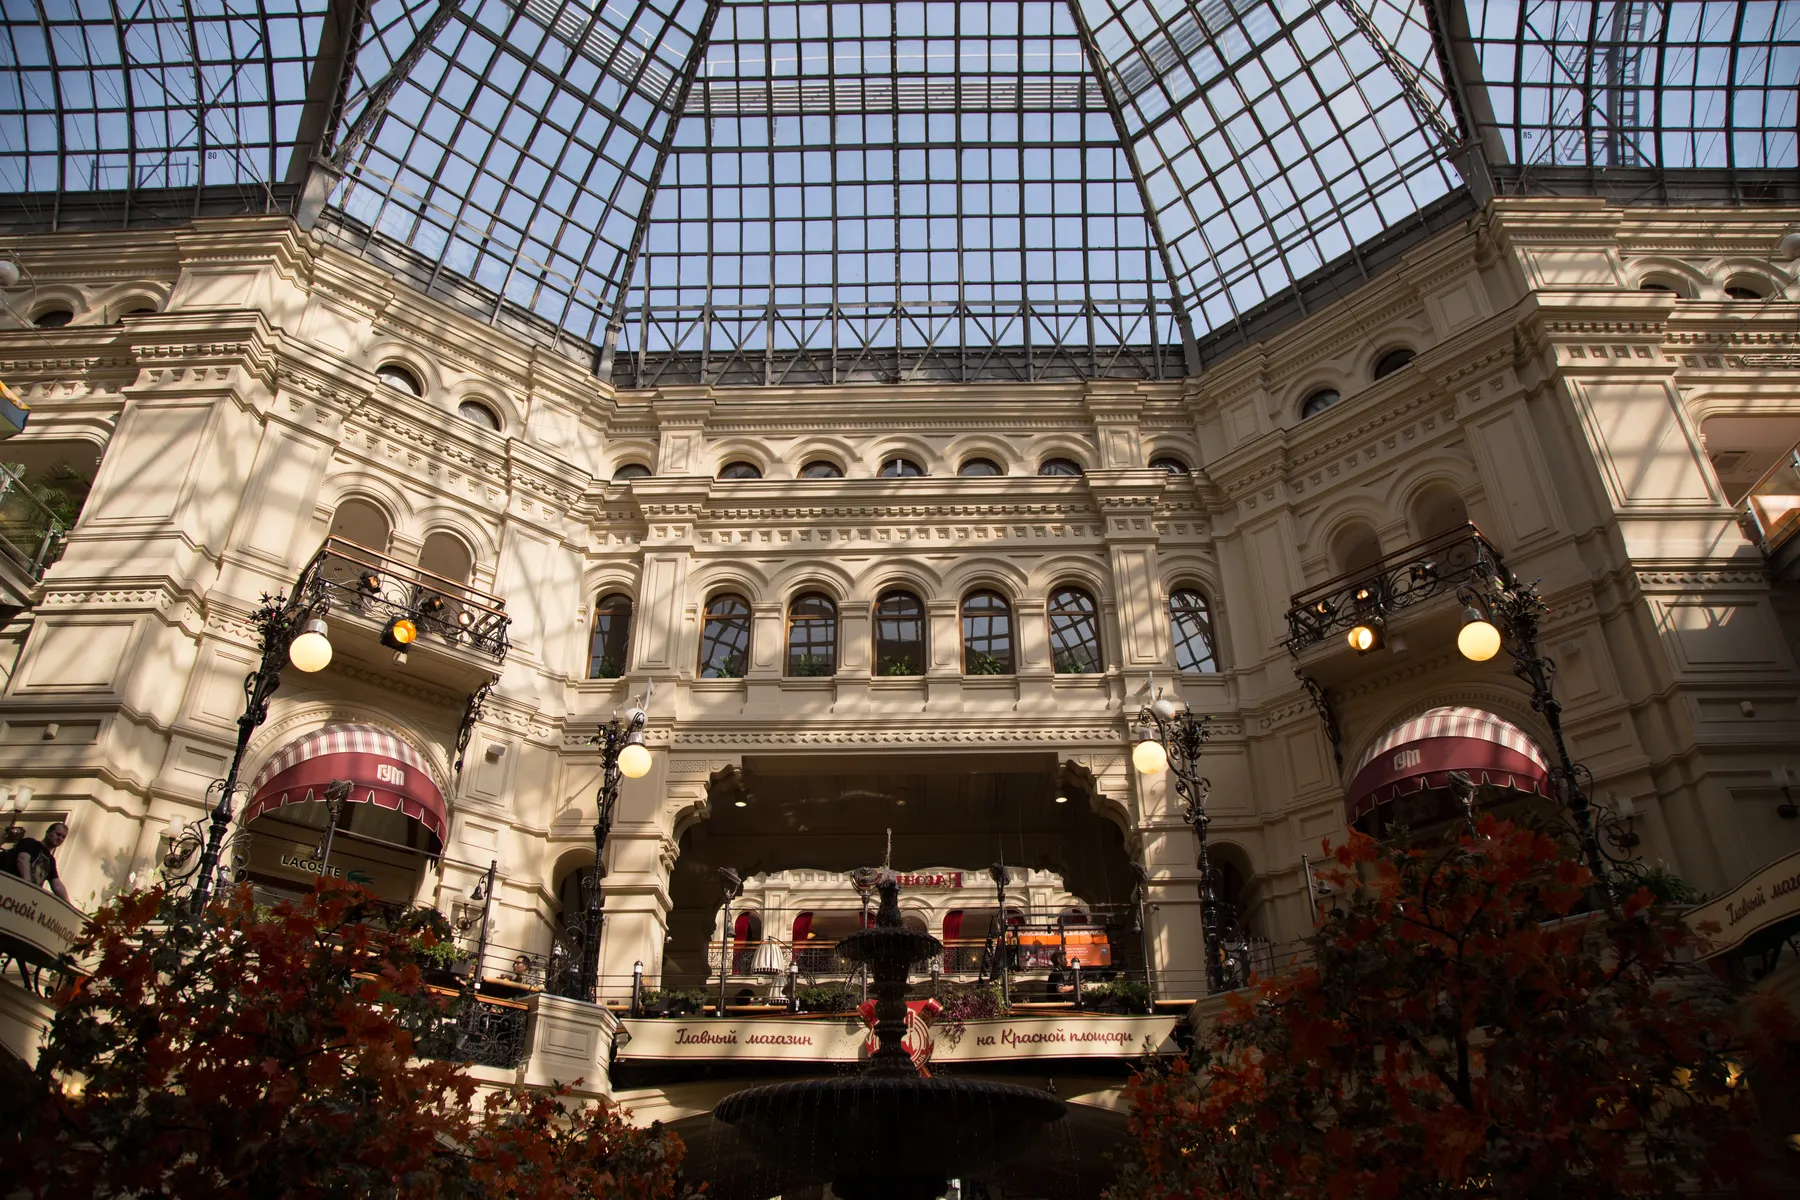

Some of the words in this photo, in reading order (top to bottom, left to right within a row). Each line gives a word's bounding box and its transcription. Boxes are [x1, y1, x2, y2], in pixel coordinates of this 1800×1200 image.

[1522, 131, 1533, 140] 85
[207, 151, 218, 160] 80
[881, 871, 964, 888] ИНОЗАЛ
[1725, 885, 1766, 927] Главный
[674, 1028, 738, 1045] Главный
[745, 1033, 813, 1046] магазин
[976, 1034, 997, 1046] на
[1000, 1028, 1066, 1049] Красной
[1069, 1031, 1133, 1047] площади
